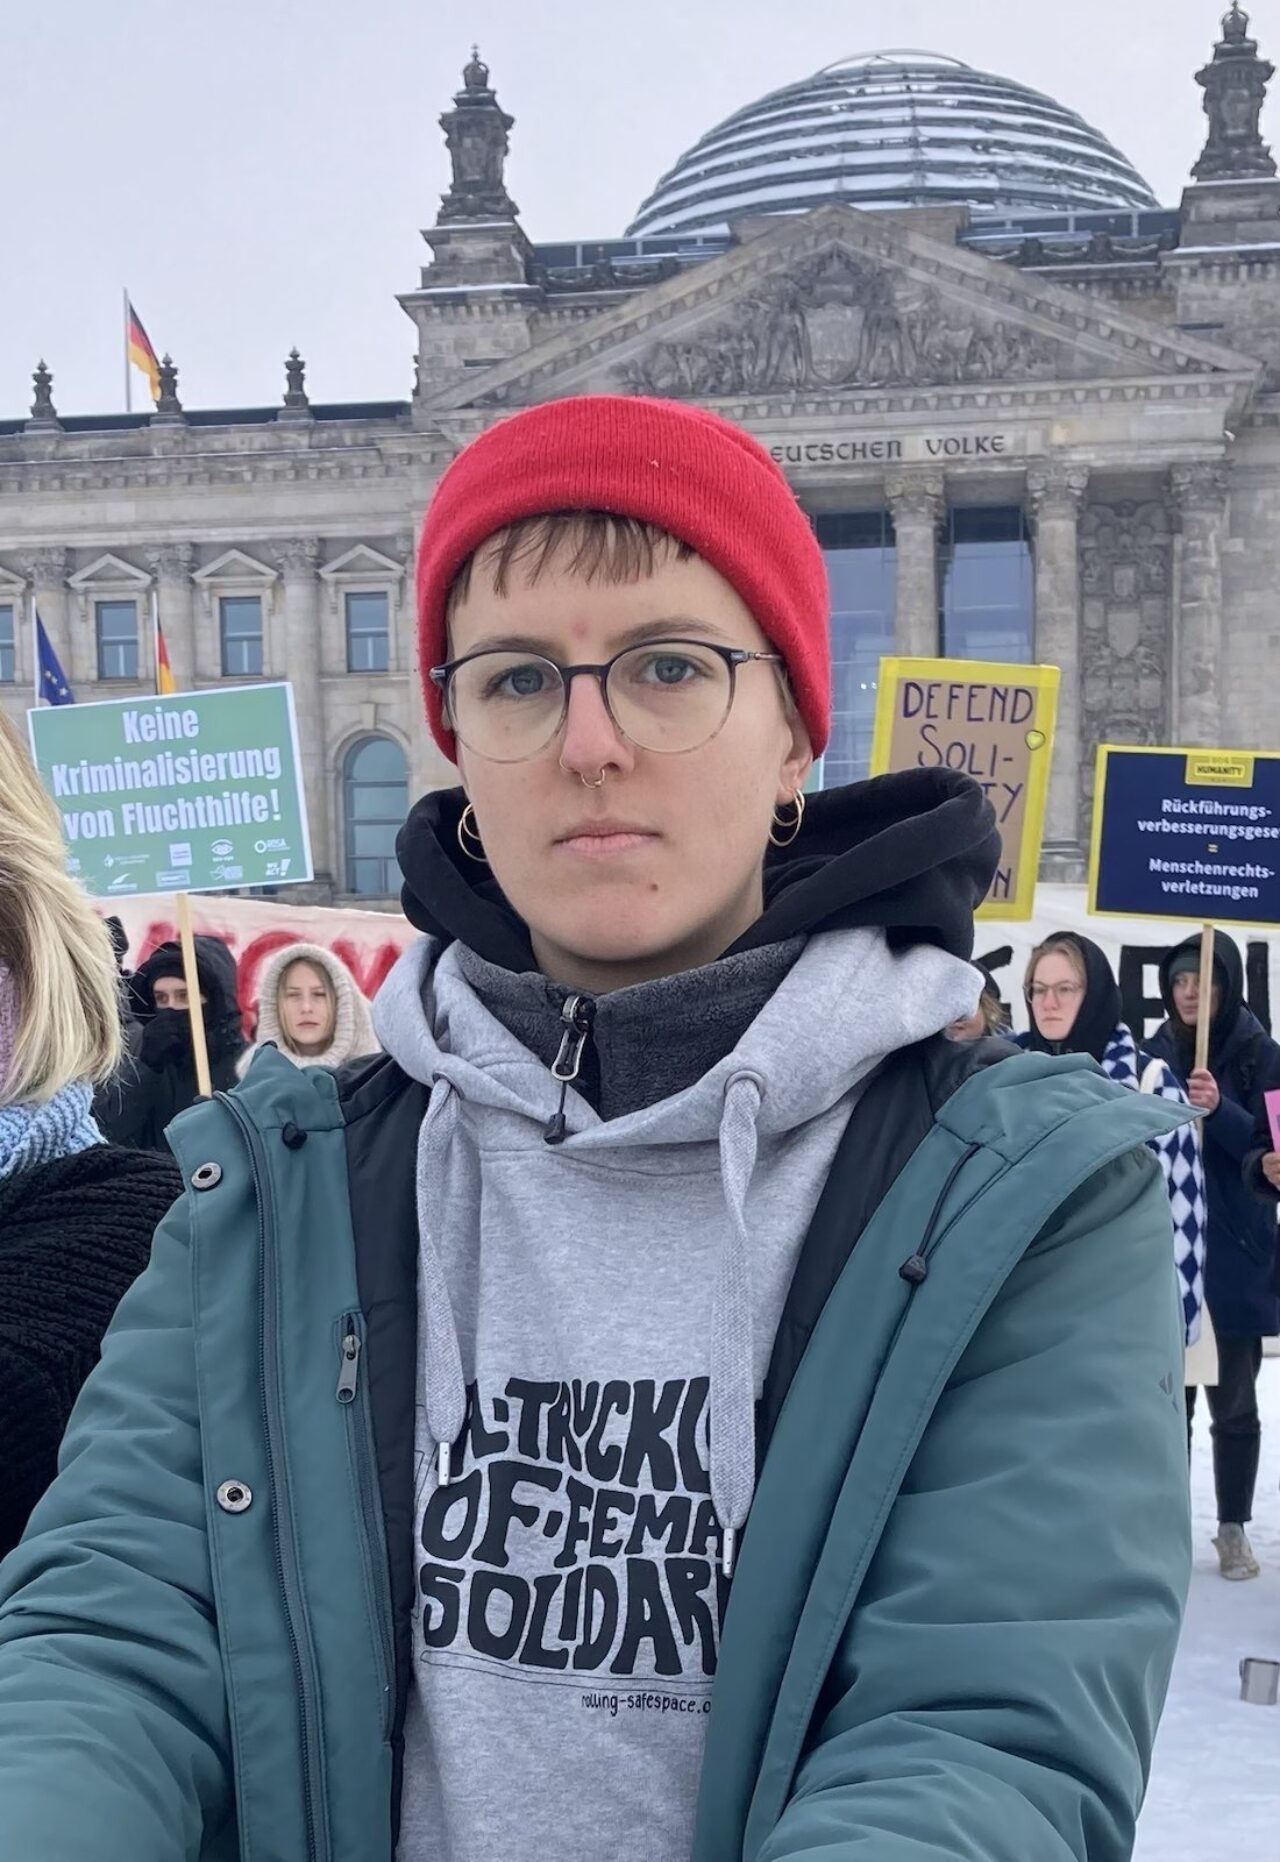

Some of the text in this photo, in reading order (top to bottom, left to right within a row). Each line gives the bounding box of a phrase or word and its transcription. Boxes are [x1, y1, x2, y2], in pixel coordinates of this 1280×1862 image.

[926, 436, 1004, 455] VOLKE
[903, 682, 1033, 724] DEFEND
[122, 706, 199, 743] Keine
[52, 747, 282, 797] Kriminalisierung
[63, 789, 282, 840] von Fluchthilfe!
[1161, 798, 1272, 820] Rückführungs-
[1137, 819, 1280, 840] verbesserungsgese
[1149, 858, 1275, 879] Menschenrechts-
[1161, 880, 1259, 900] verletzungen
